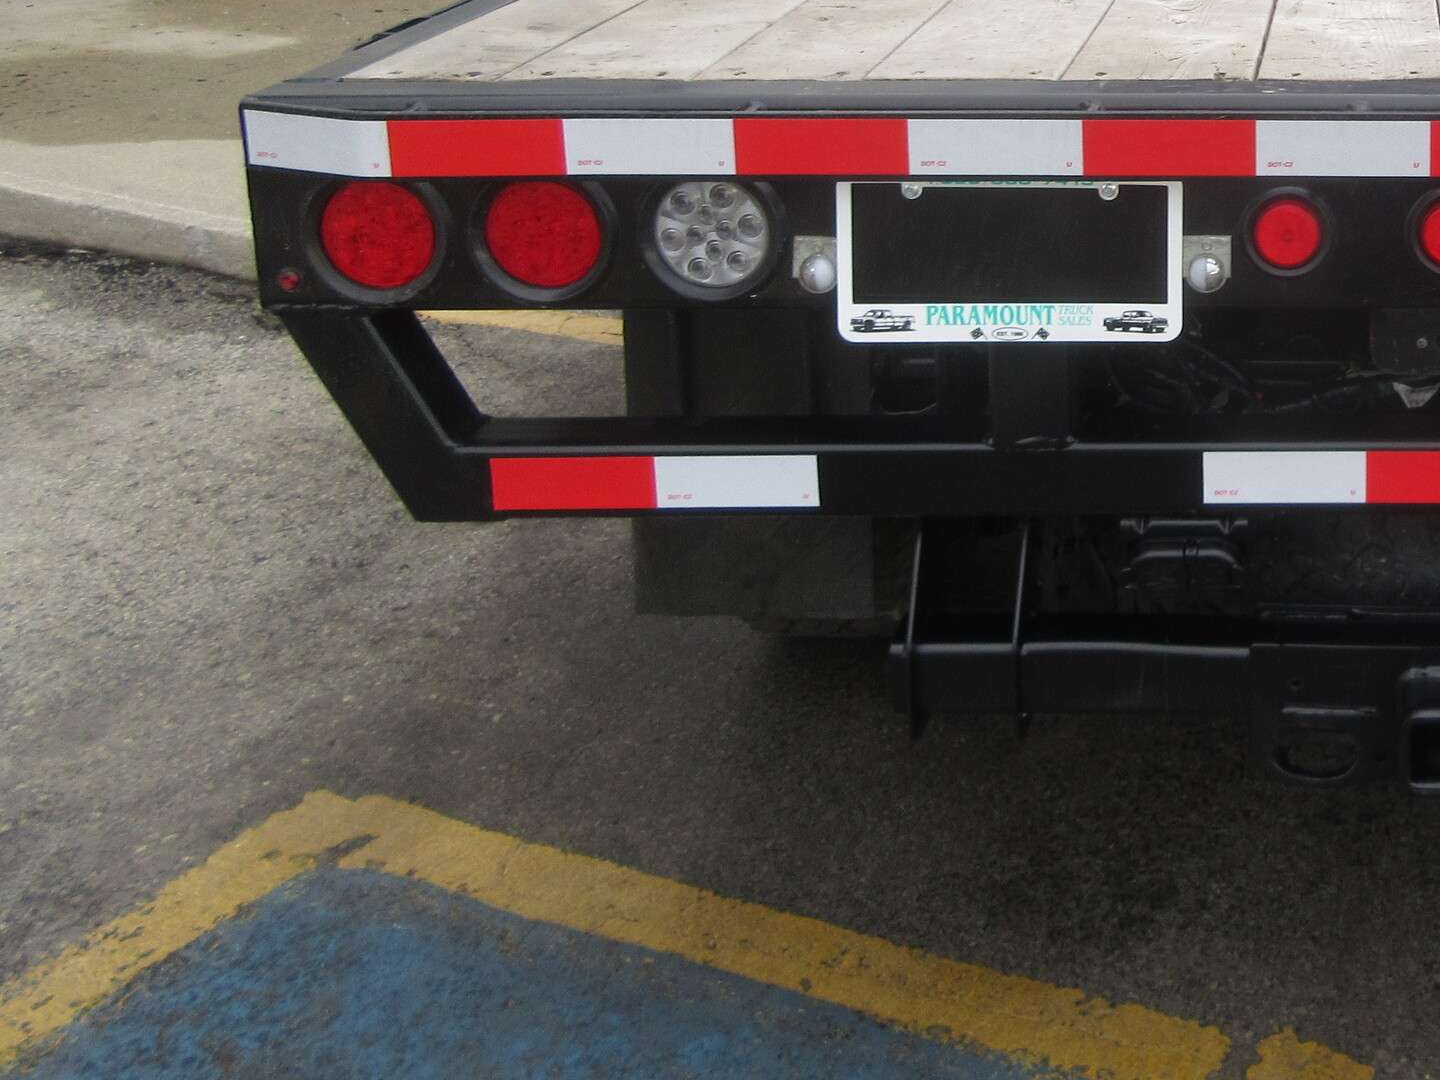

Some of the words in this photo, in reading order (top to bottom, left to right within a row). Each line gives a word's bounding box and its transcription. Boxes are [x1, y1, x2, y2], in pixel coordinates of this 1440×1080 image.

[1058, 304, 1094, 315] TRUCK
[926, 305, 1056, 326] PARAMOUNT
[1058, 315, 1092, 326] SALES
